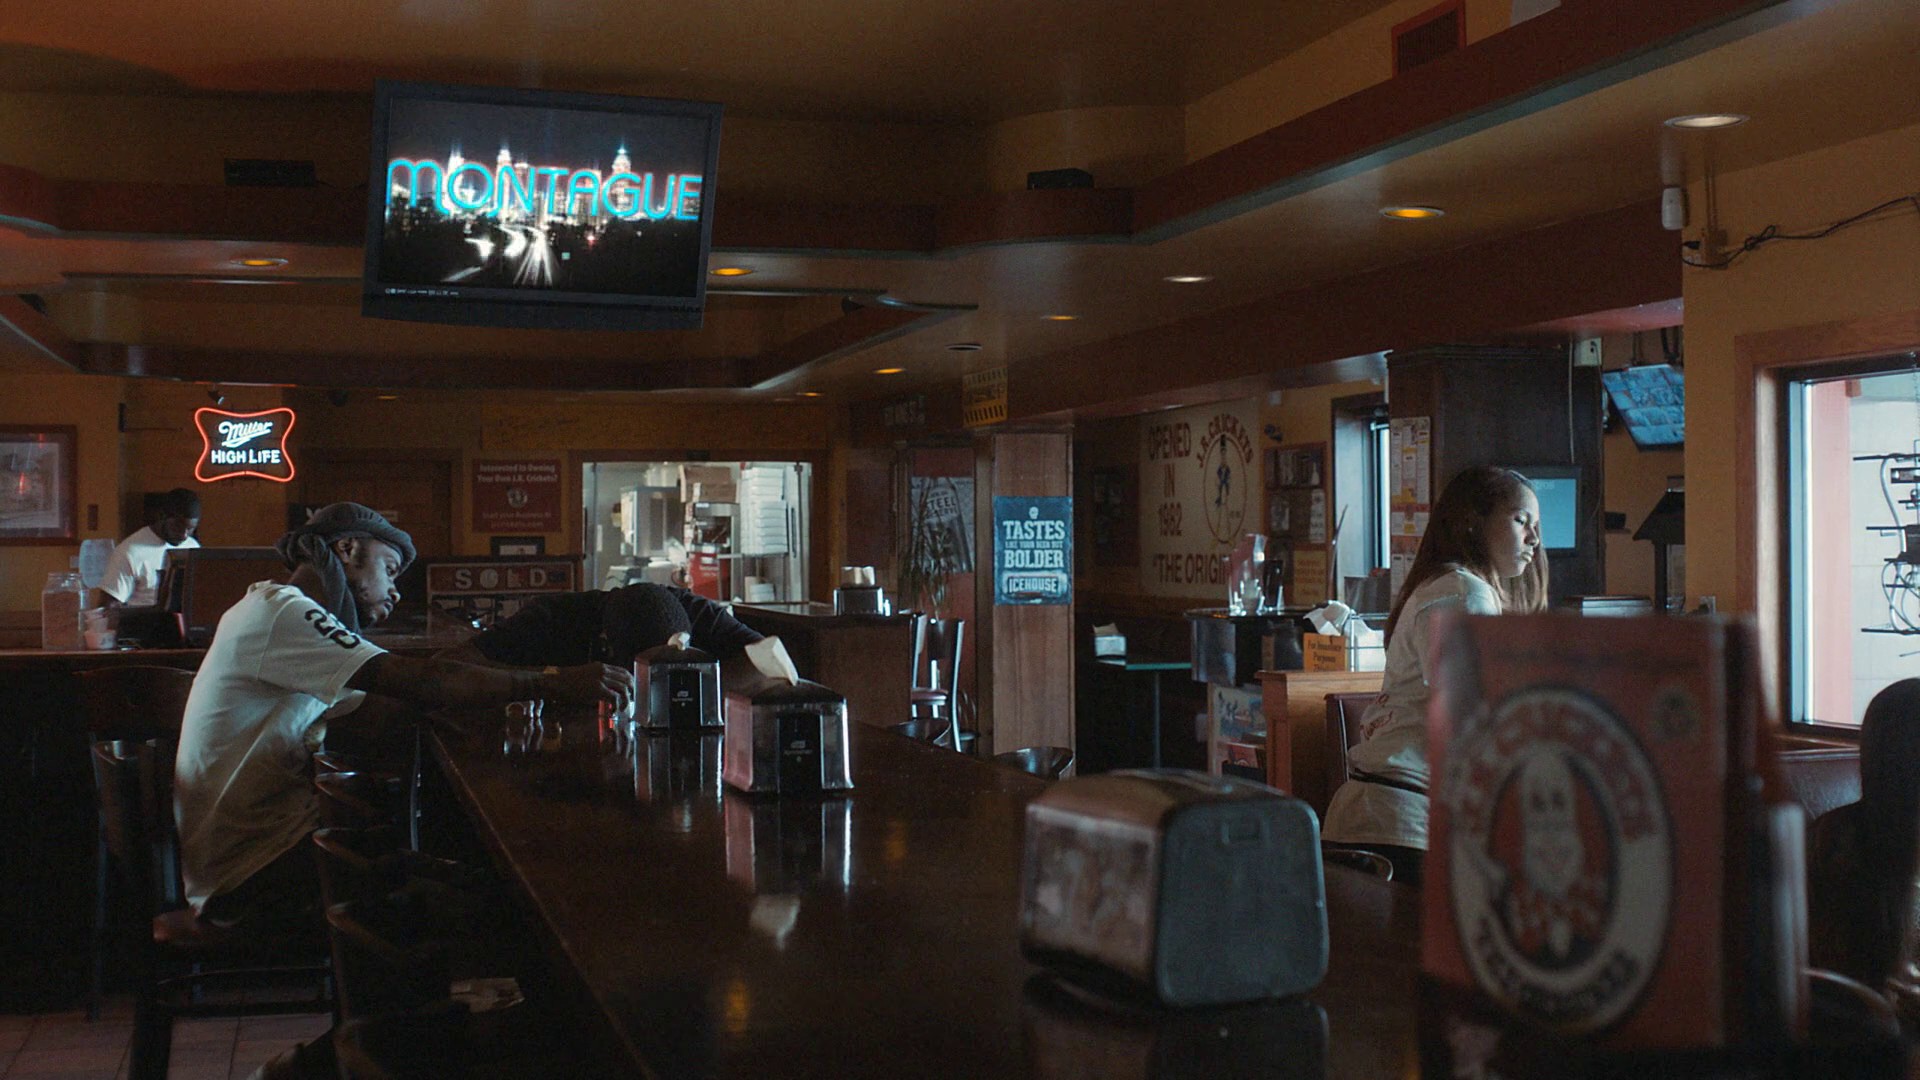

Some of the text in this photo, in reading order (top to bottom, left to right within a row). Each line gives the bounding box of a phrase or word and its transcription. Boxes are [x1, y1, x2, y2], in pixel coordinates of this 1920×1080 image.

[386, 157, 704, 222] MONTAGUE
[218, 420, 273, 447] Miller
[1147, 422, 1191, 461] OPENED
[211, 448, 282, 465] HIGH LIFE
[1163, 463, 1176, 498] IN
[927, 496, 956, 509] TEEL
[1003, 519, 1066, 541] TASTES
[1004, 549, 1065, 569] BOLDER
[1185, 553, 1233, 585] ORIGIN
[1008, 577, 1059, 594] ICEHOUSE
